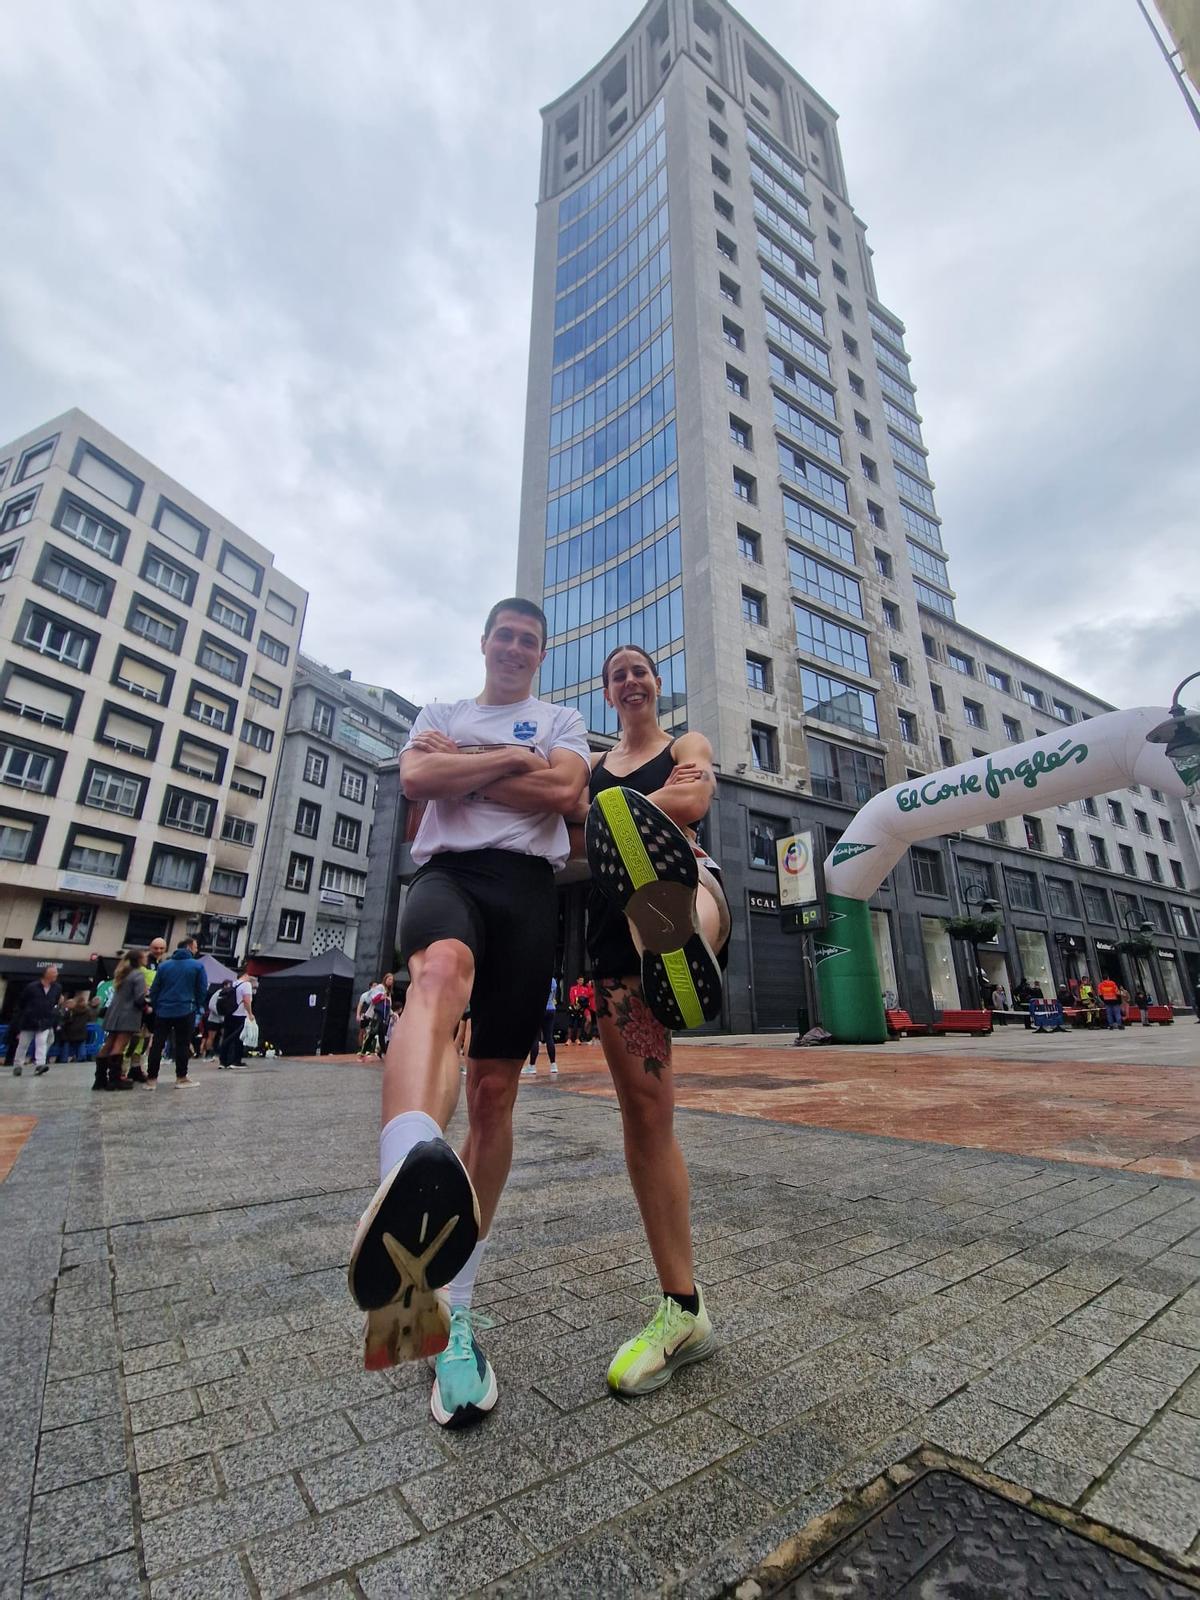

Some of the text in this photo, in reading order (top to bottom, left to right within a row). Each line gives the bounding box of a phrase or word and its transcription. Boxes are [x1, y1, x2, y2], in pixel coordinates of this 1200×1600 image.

[896, 738, 1089, 812] El Corte Inglés
[666, 957, 691, 993] NIKE
